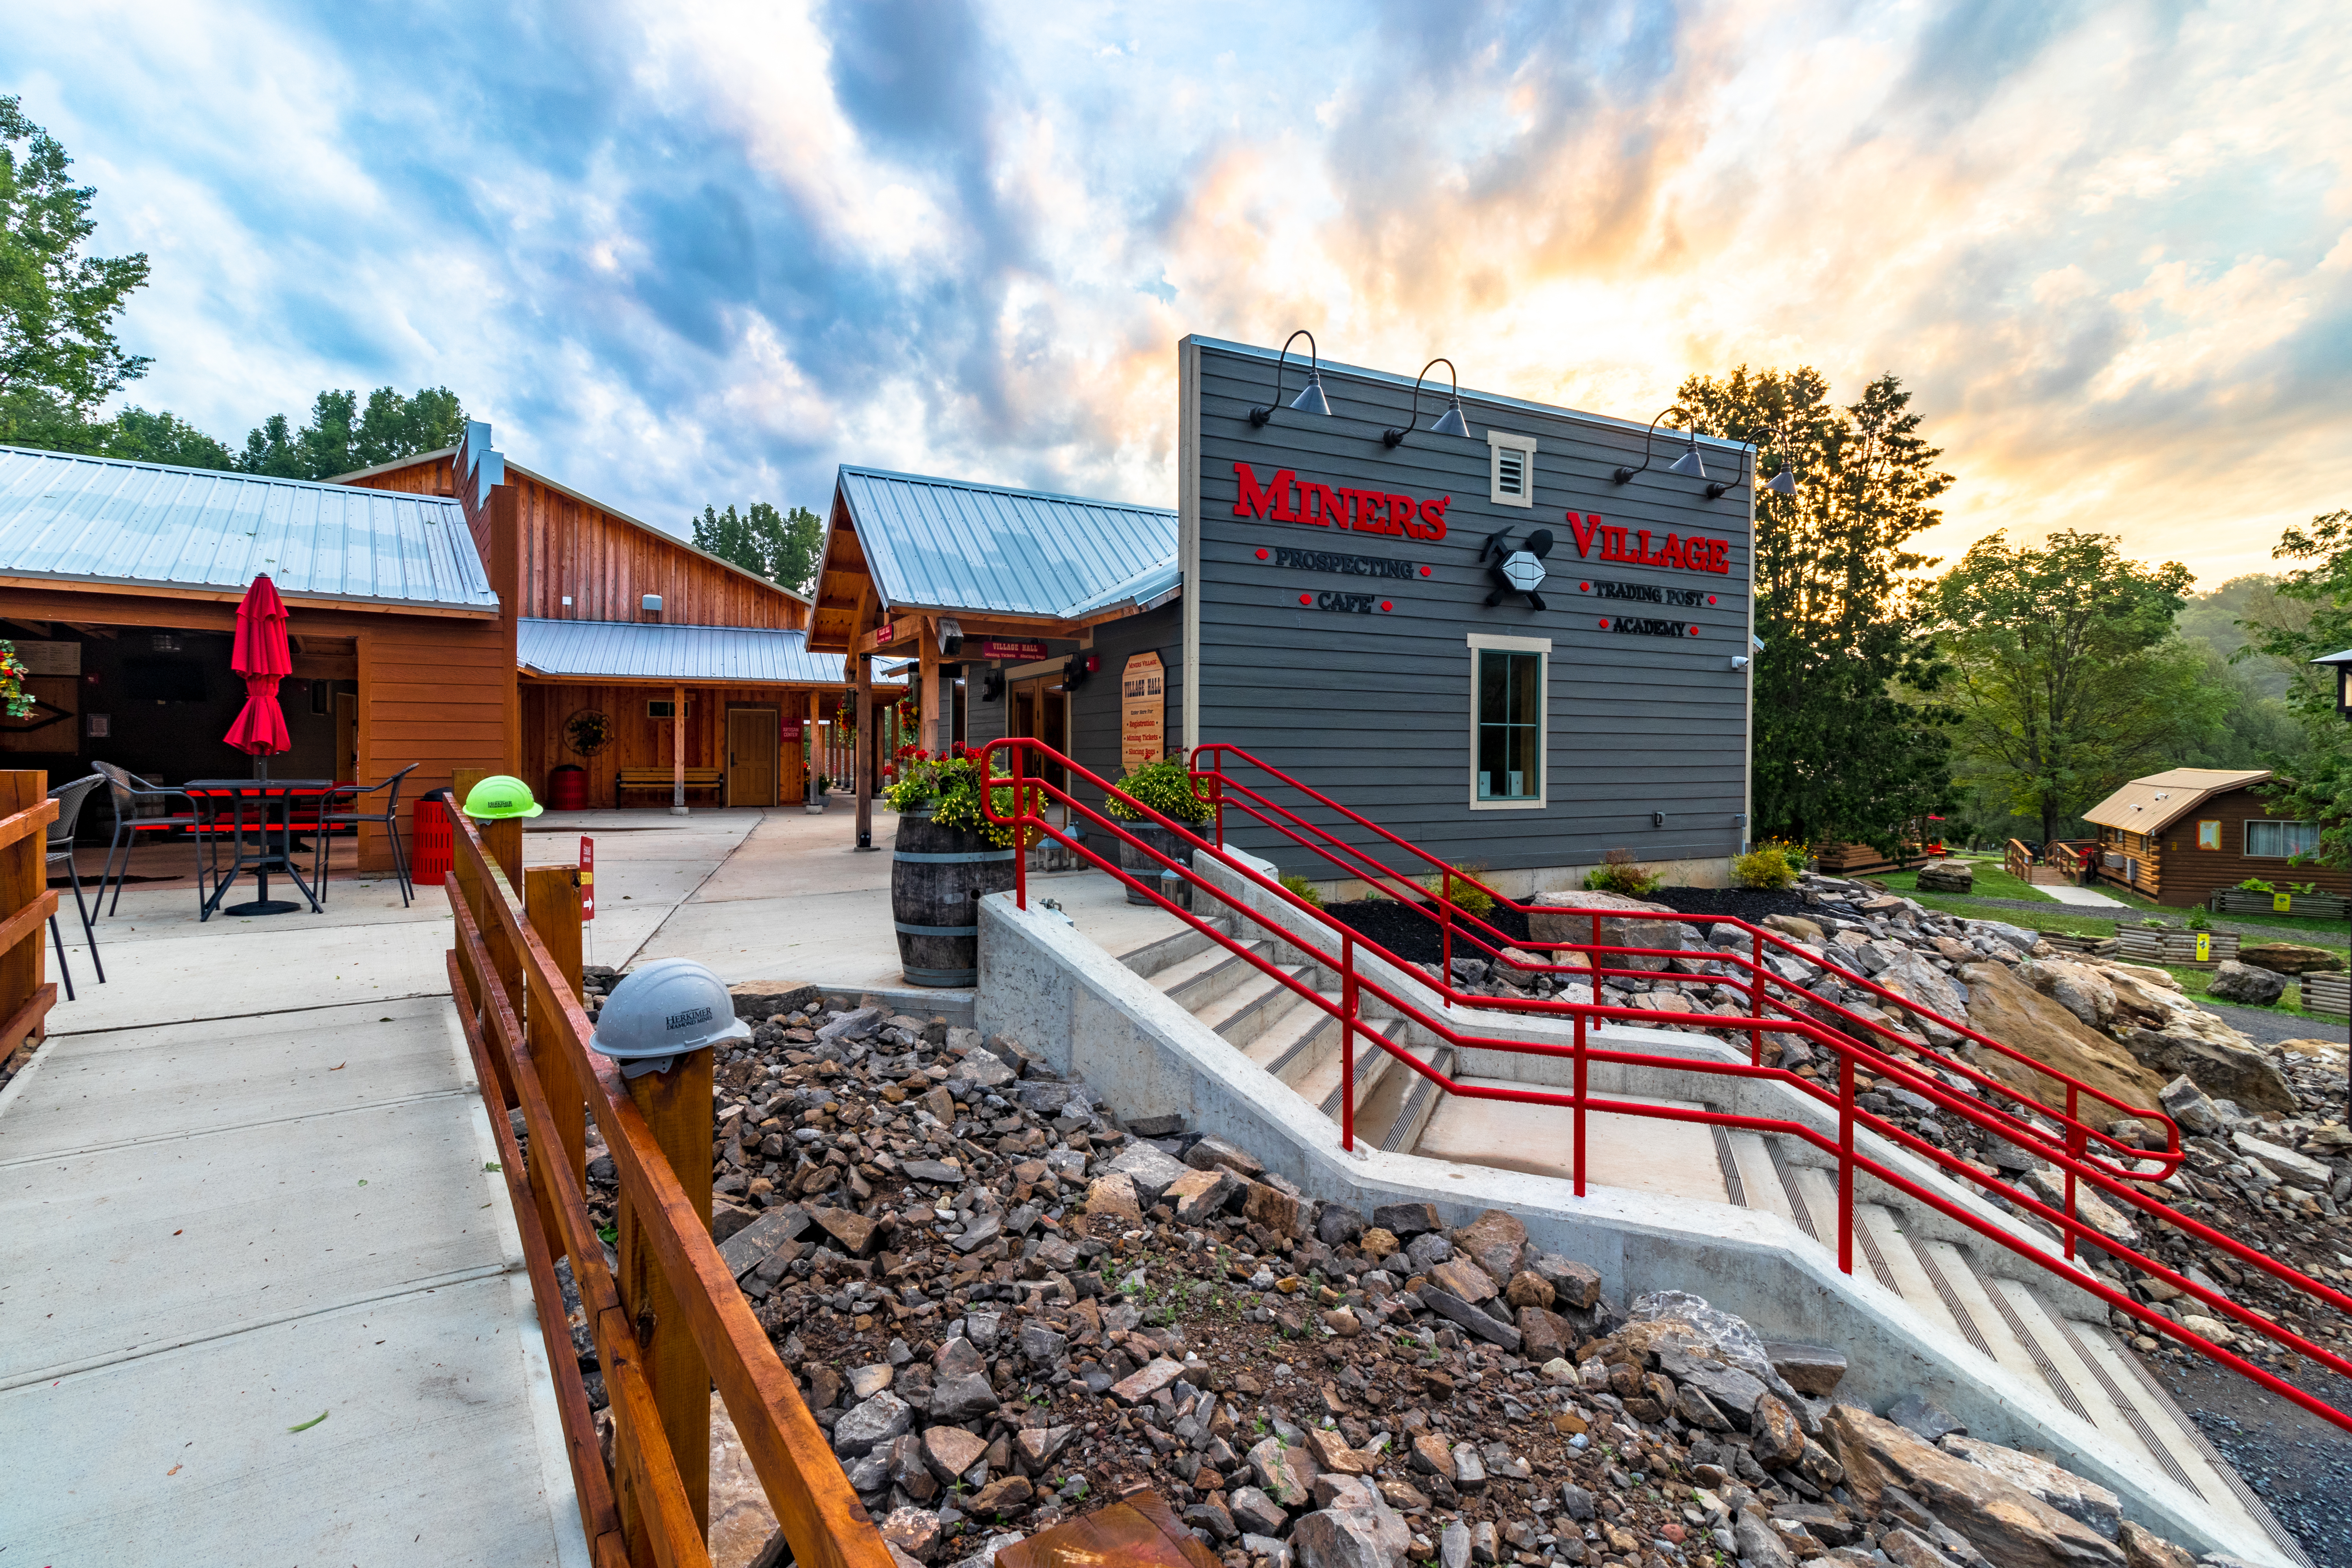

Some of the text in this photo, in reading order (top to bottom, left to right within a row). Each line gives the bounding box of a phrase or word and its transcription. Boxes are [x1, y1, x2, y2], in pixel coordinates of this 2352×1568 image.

[1566, 512, 1729, 574] VILLAGE
[1275, 547, 1415, 579] PROSPECTING
[1594, 581, 1704, 606] TRADING POST
[1613, 617, 1686, 637] ACADEMY
[992, 643, 1038, 652] VILLAGE HALL
[1125, 677, 1161, 698] VILLAGE HALL
[1129, 719, 1155, 729] Registration
[1127, 734, 1141, 742] Mining
[1145, 748, 1155, 756] Bags
[666, 1007, 712, 1024] HERKIMER
[666, 1015, 713, 1030] DIAMOND MINES
